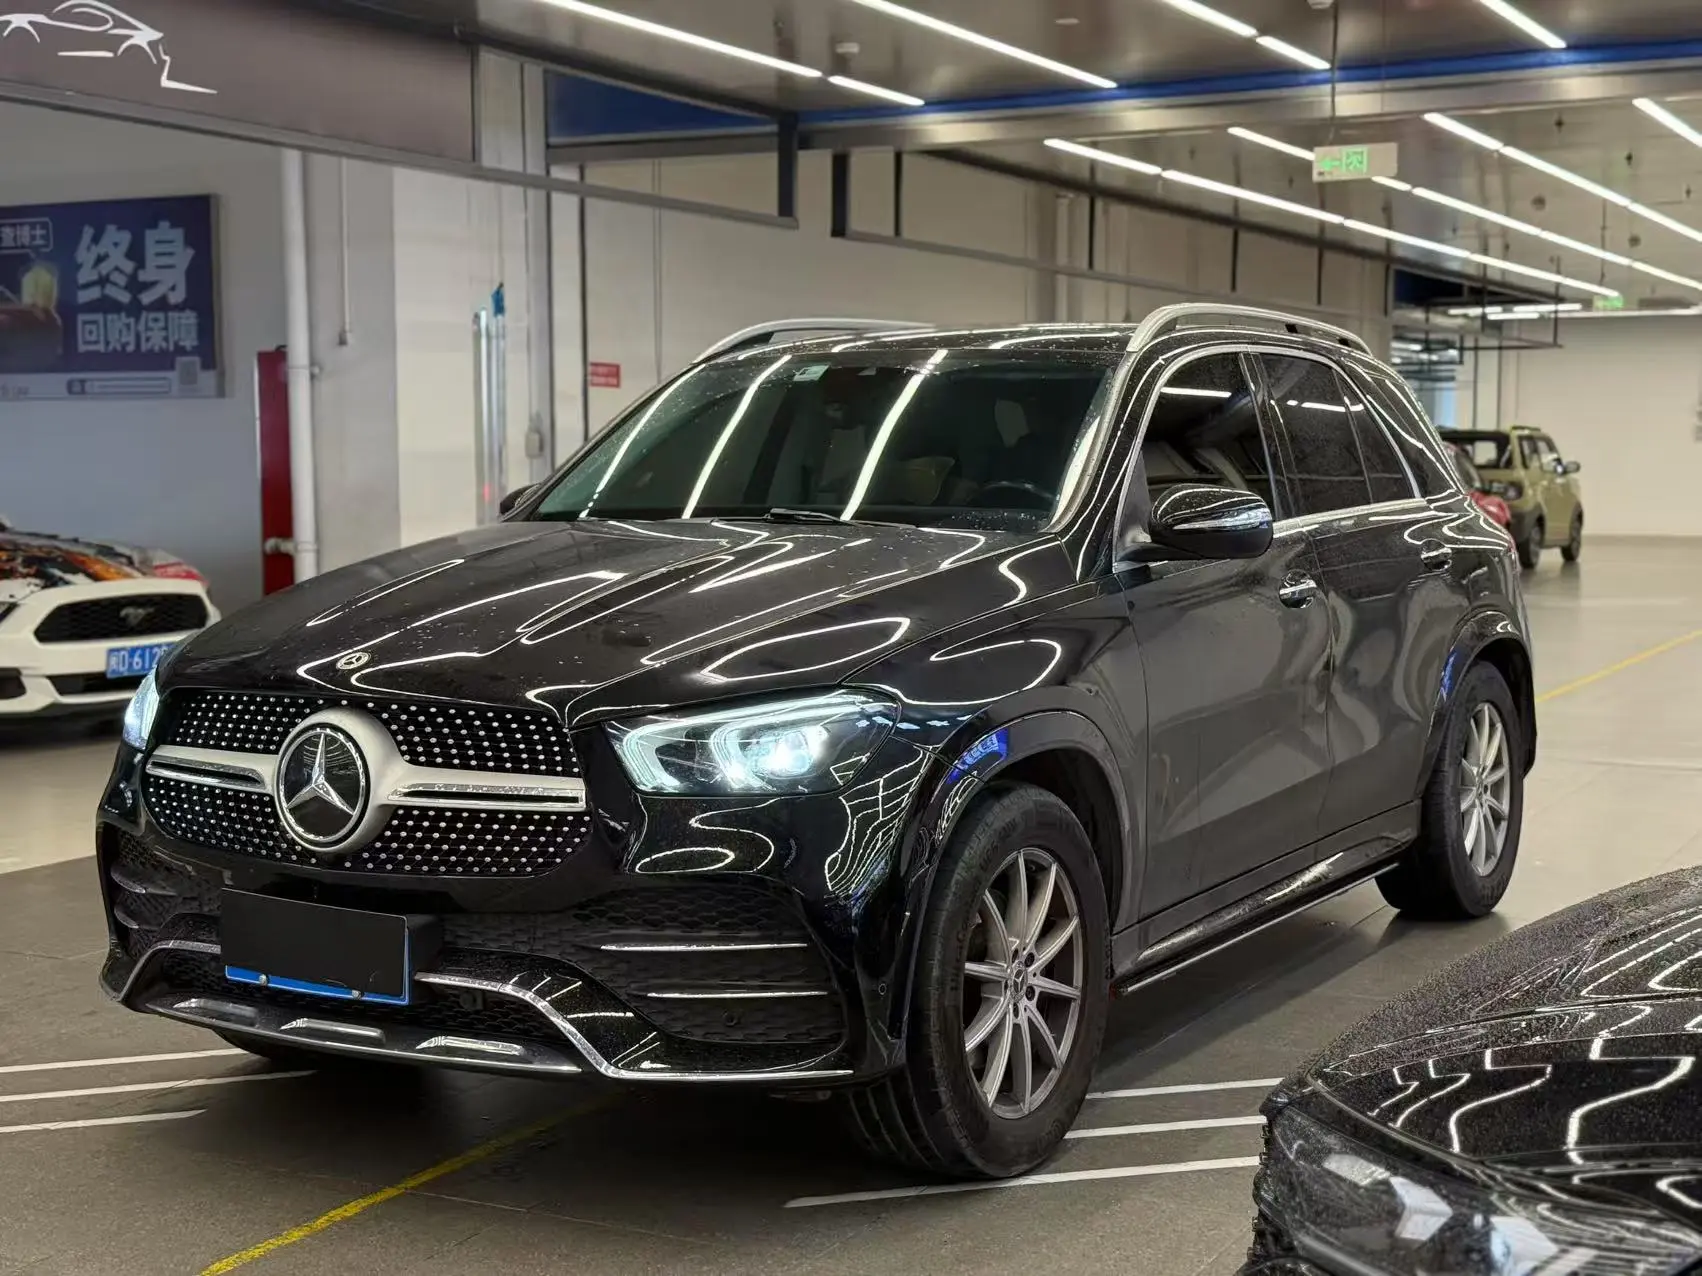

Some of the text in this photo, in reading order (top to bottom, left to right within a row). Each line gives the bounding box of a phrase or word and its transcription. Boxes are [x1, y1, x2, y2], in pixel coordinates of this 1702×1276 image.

[74, 220, 196, 305] 终身
[77, 309, 200, 352] 回购保障
